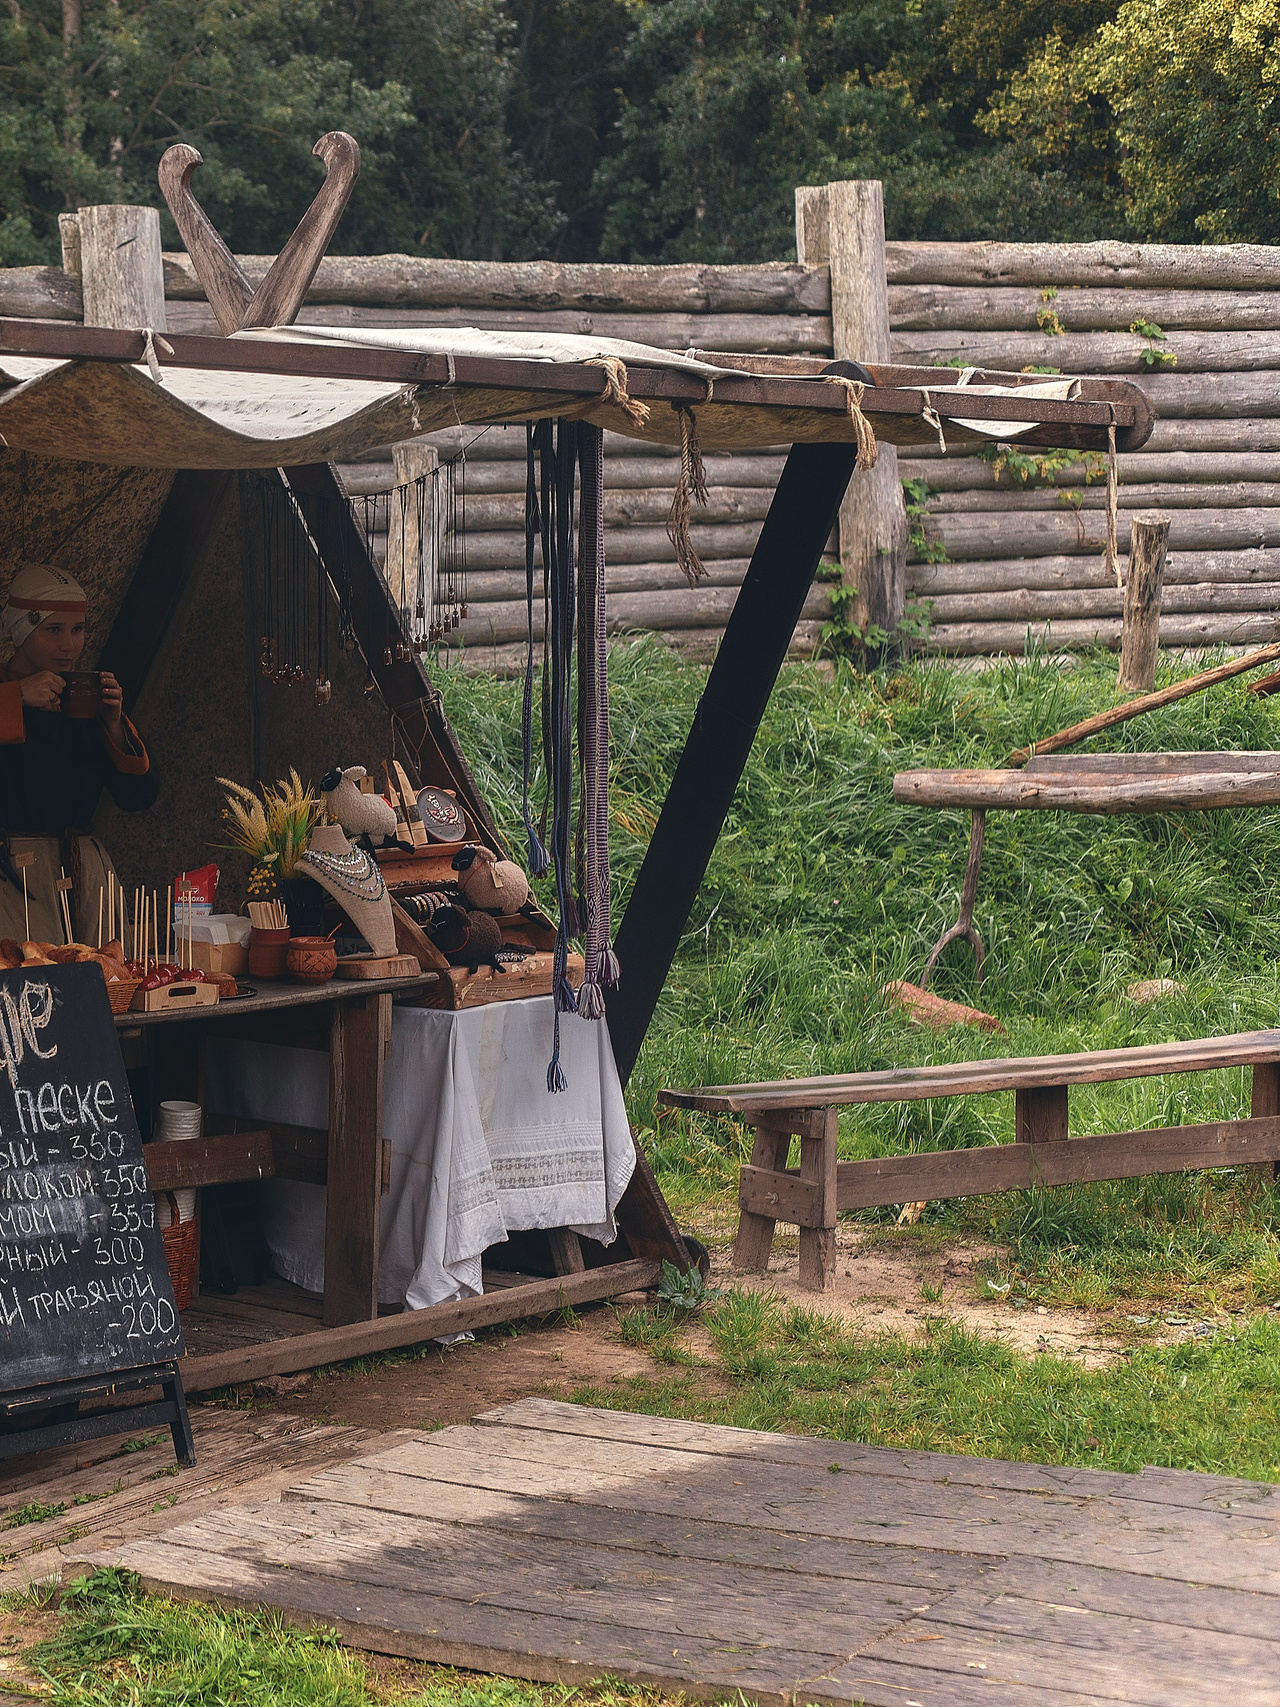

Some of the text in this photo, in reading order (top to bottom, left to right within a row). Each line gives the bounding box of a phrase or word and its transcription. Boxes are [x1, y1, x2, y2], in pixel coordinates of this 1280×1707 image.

[70, 1131, 125, 1161] 350
[102, 1164, 147, 1198] 350
[110, 1203, 155, 1232] 350
[94, 1236, 144, 1265] 300
[28, 1266, 156, 1320] ТРАВЯНОЙ
